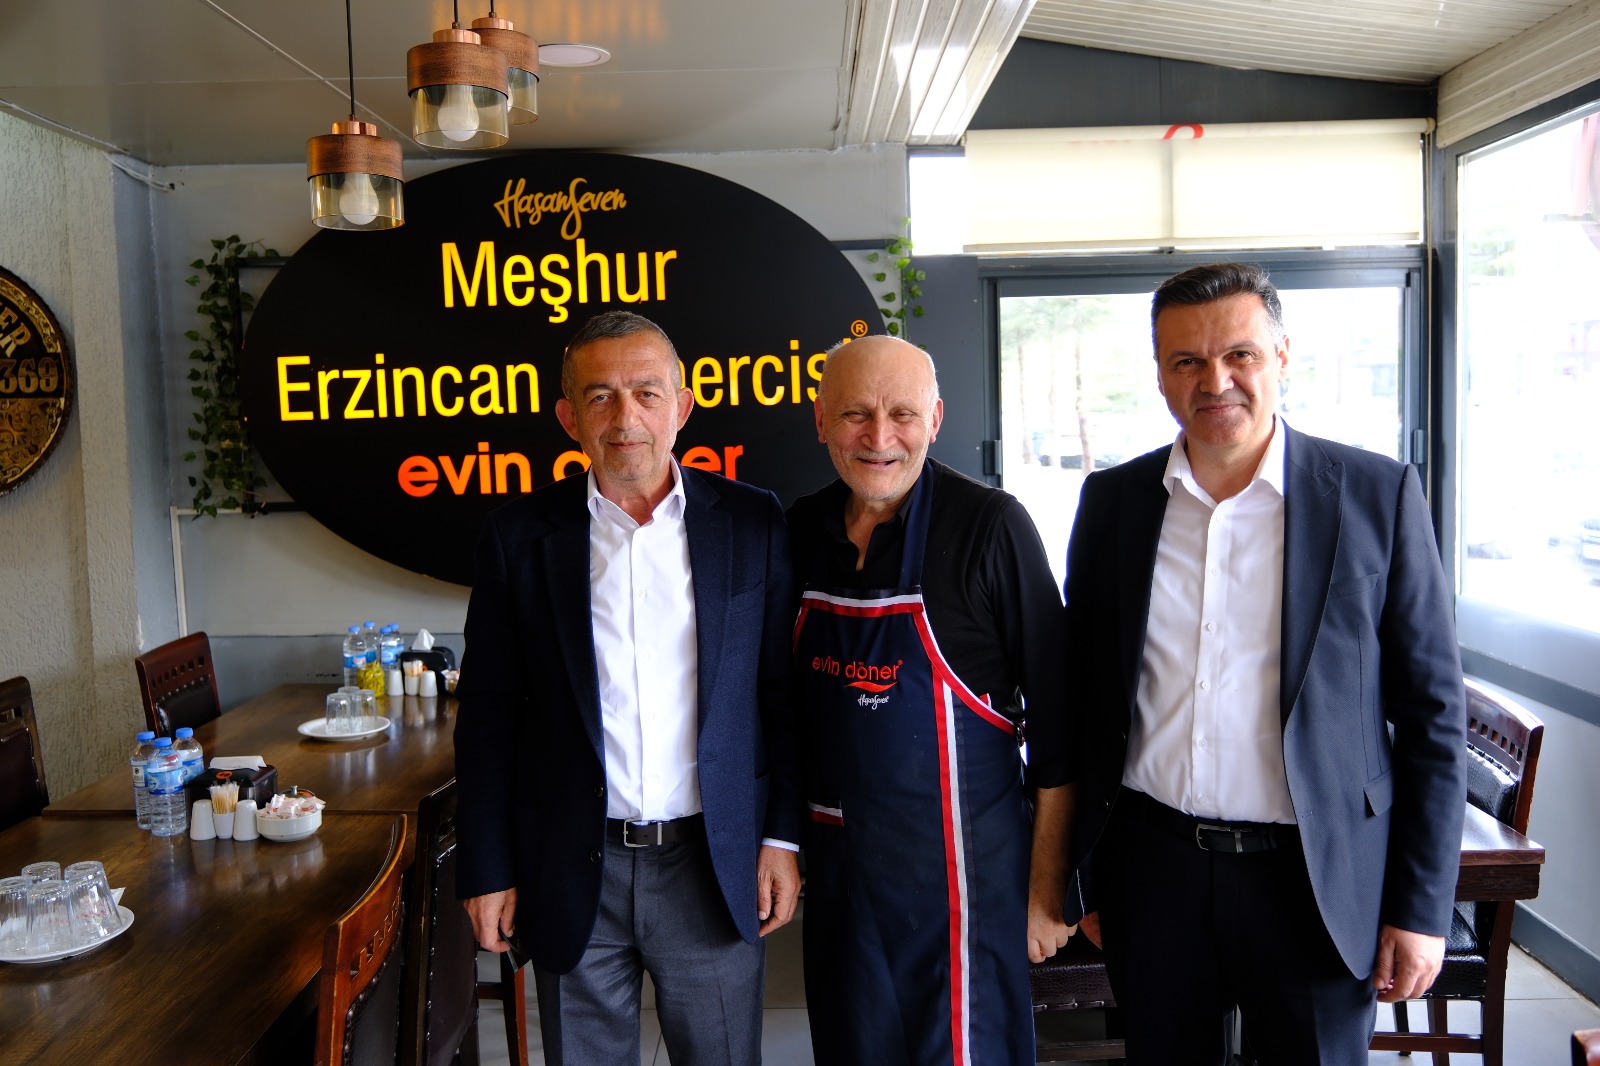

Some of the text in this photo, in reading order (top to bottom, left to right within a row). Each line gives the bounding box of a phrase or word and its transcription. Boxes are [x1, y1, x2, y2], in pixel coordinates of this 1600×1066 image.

[441, 238, 678, 324] Meşhur
[0, 302, 32, 359] ER
[276, 352, 540, 422] Erzincan
[397, 441, 532, 498] evin
[812, 655, 900, 680] evin döner
